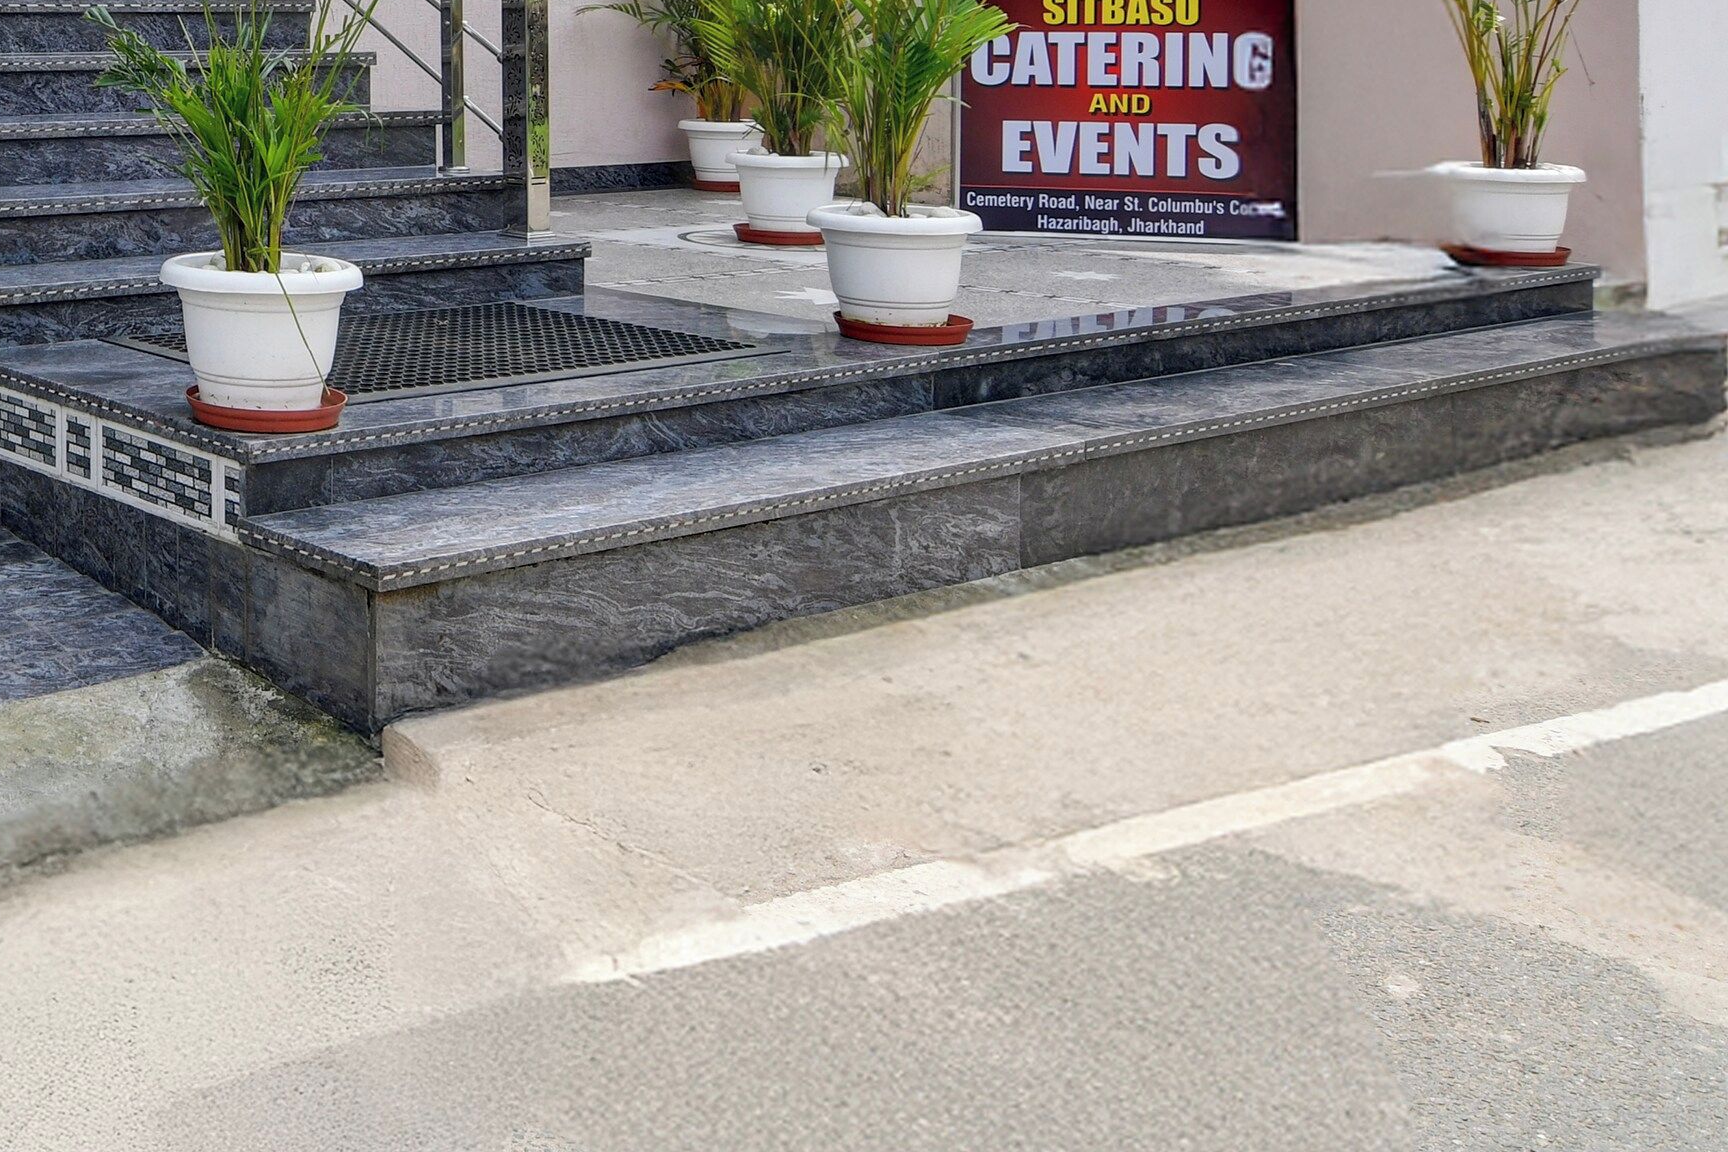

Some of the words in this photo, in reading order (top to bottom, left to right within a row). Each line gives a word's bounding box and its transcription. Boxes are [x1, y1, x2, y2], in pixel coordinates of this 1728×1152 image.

[970, 31, 1273, 89] CATERING
[1088, 93, 1151, 115] AND
[1001, 119, 1240, 180] EVENTS
[966, 191, 1034, 211] Cemetery
[1038, 193, 1080, 212] Road,
[1084, 195, 1119, 211] Near
[1123, 196, 1143, 212] St.
[1148, 197, 1225, 215] Columbu's
[1037, 214, 1123, 234] Hazaribagh,
[1127, 217, 1204, 235] Jharkhand
